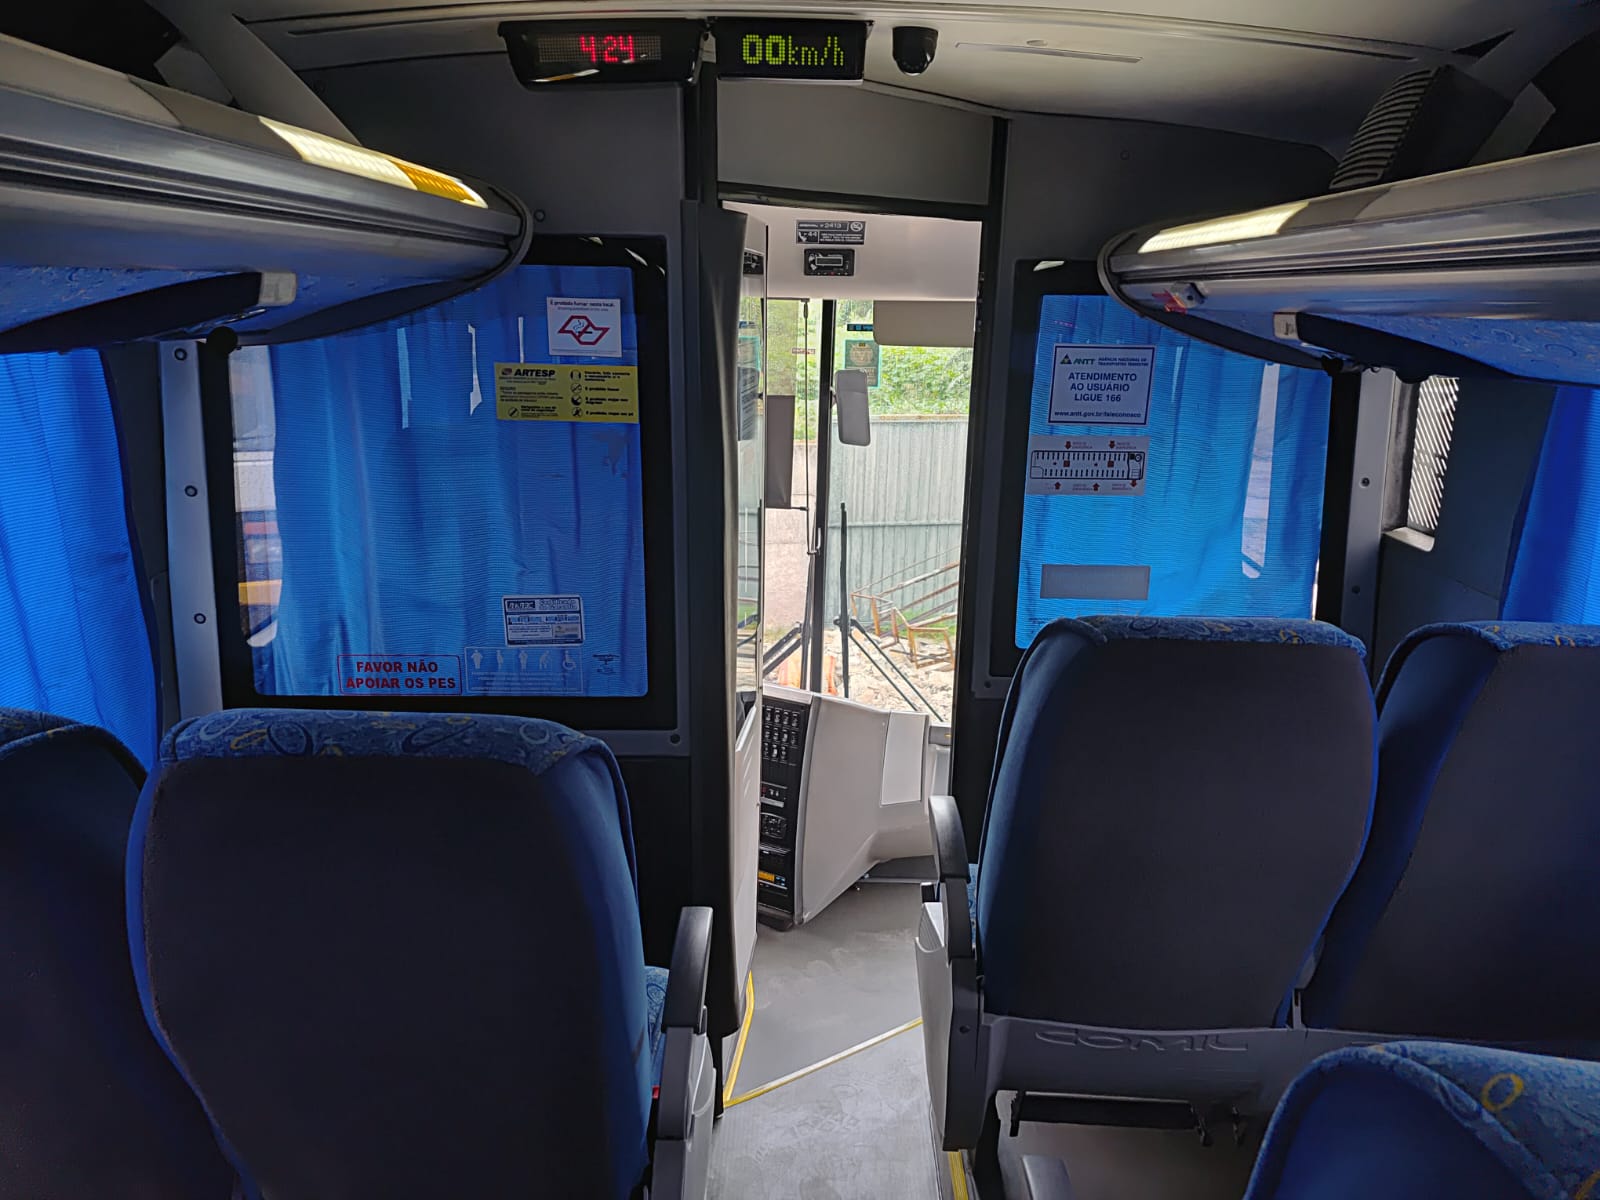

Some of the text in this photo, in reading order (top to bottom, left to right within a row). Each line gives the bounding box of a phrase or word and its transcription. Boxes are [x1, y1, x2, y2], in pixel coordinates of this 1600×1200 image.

[514, 368, 556, 377] ARTESP
[1068, 372, 1138, 382] ATENDIMENTO
[1070, 382, 1130, 392] AO USUÁRIO
[1074, 393, 1121, 402] LIGUE 166
[356, 659, 438, 673] FAVOR NÃO
[346, 677, 400, 689] APOIAR
[404, 677, 424, 689] OS
